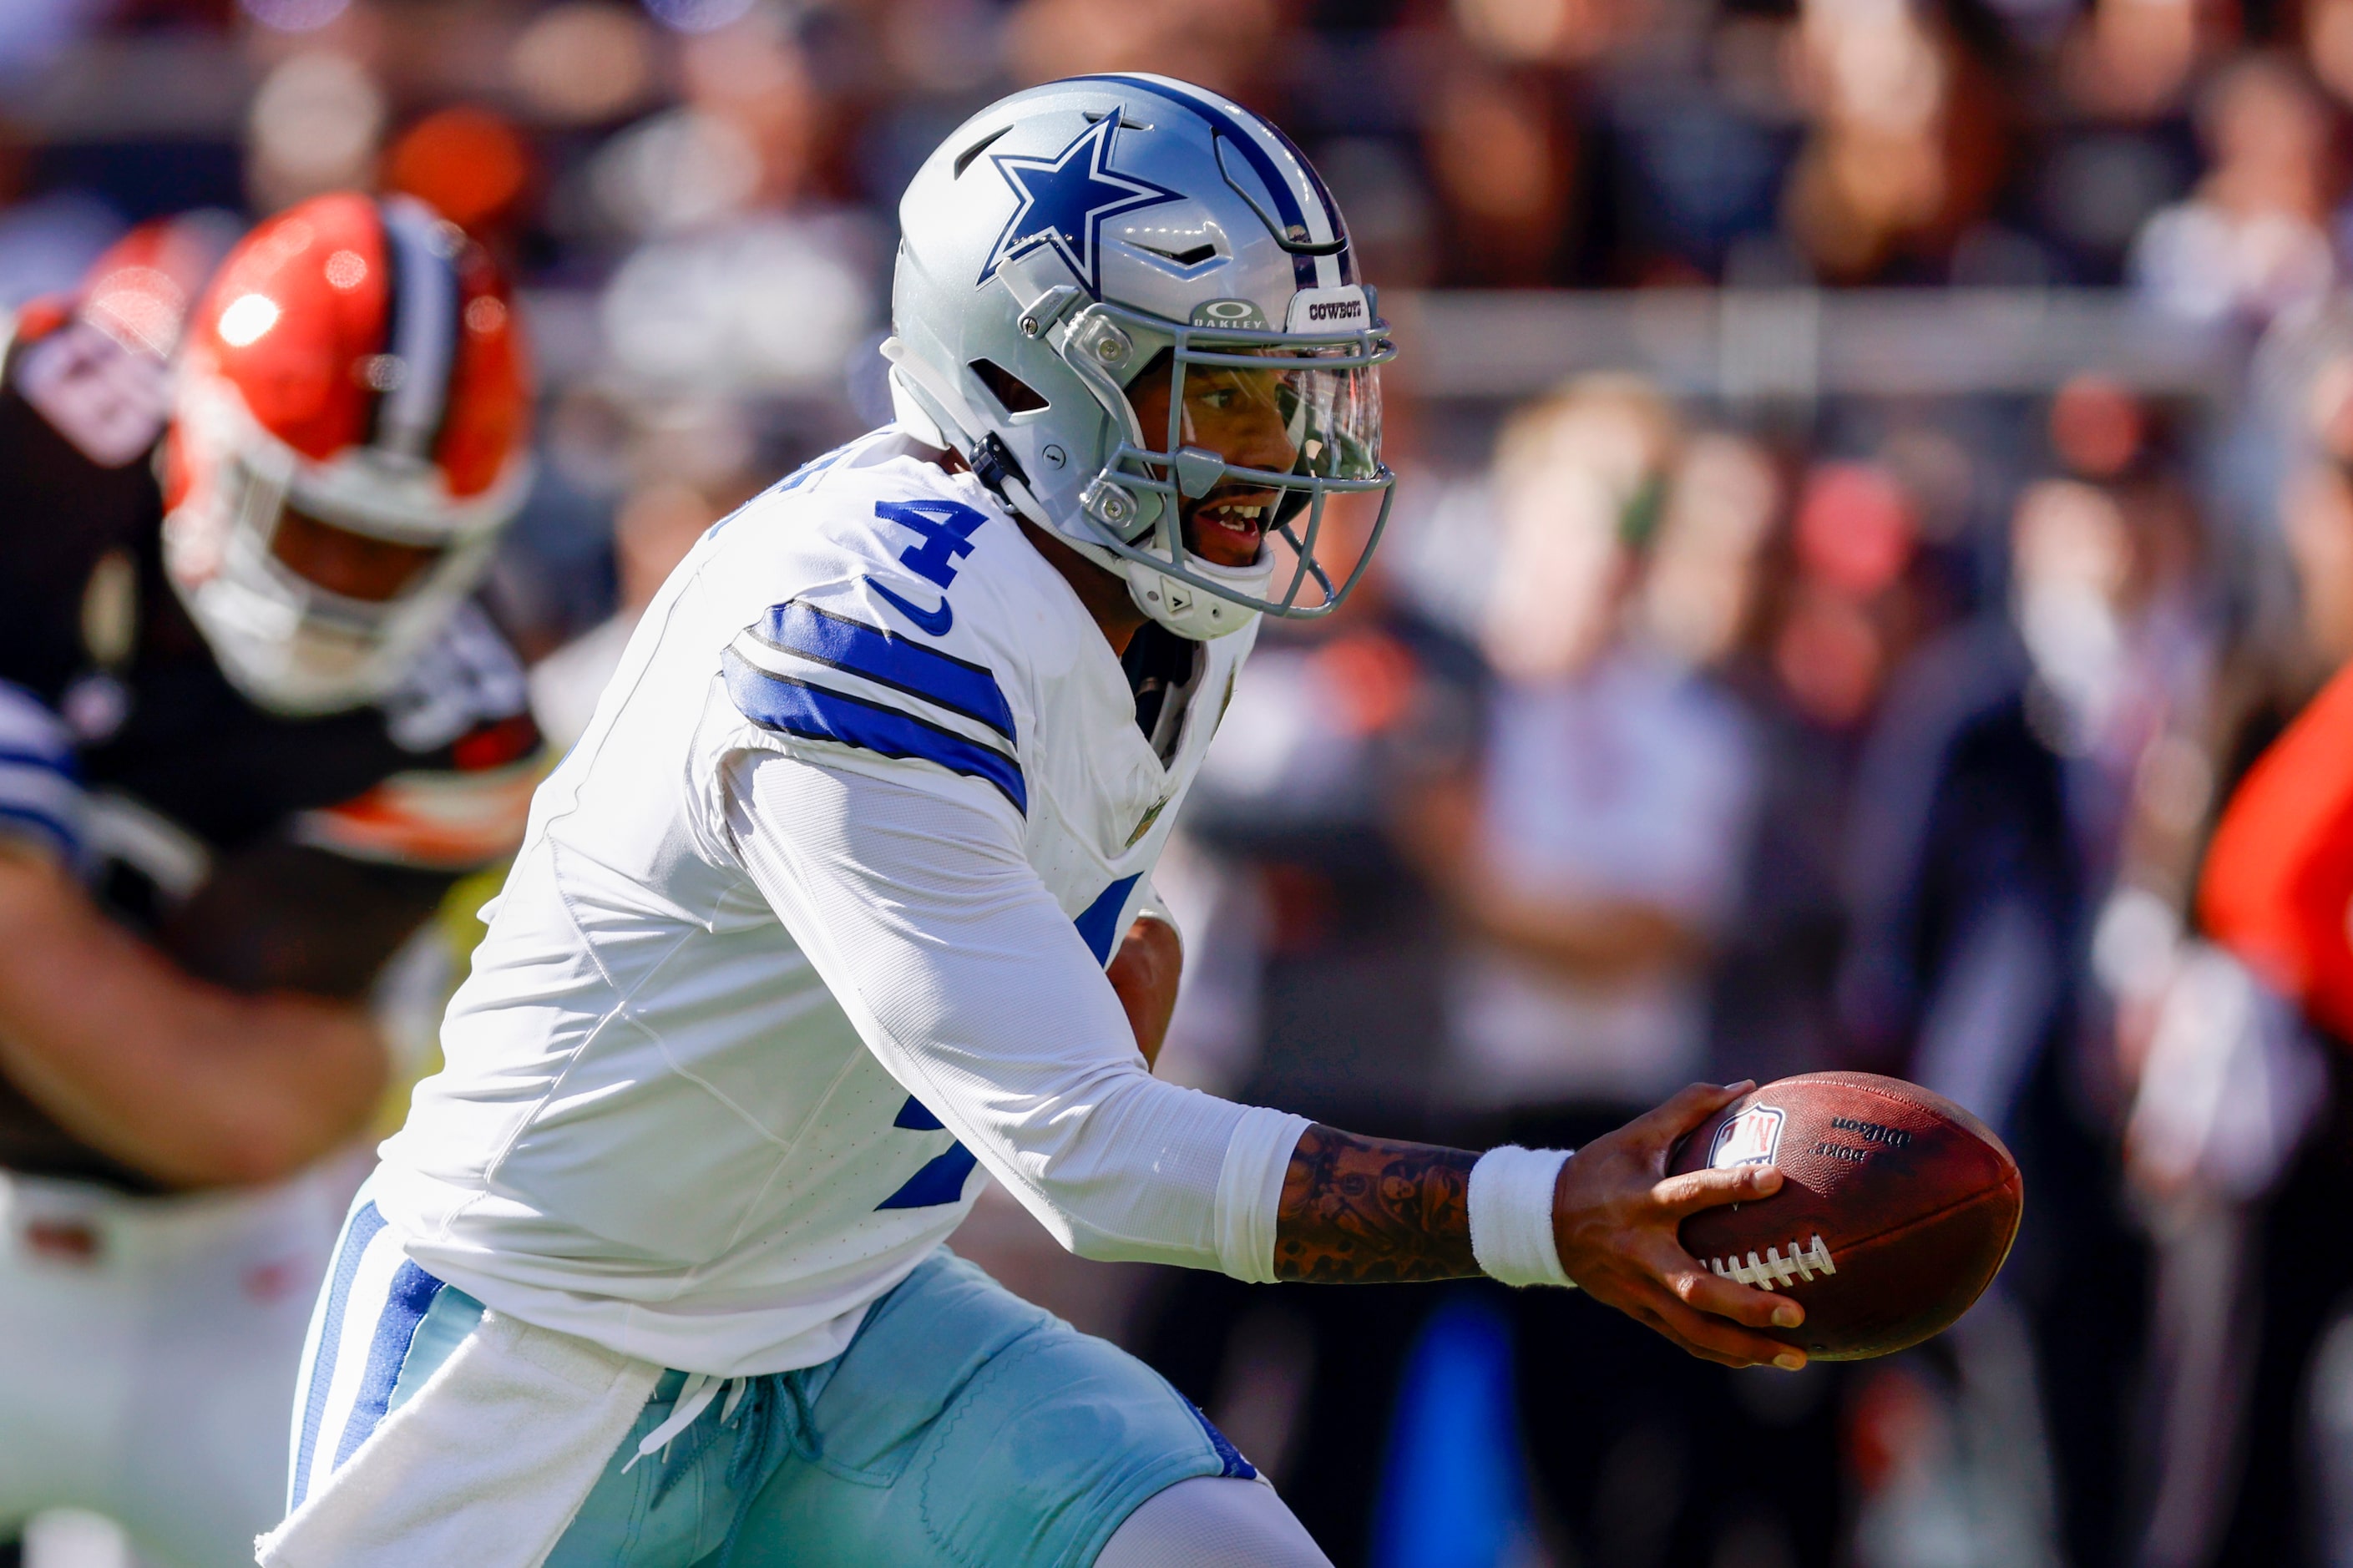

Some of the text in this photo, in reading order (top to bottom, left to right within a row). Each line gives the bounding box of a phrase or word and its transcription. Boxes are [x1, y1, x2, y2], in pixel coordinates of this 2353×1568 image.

[1194, 318, 1263, 329] OAKLEY
[1309, 300, 1362, 321] COWBOYS
[874, 499, 990, 590] 4
[1831, 1115, 1912, 1149] Wilson
